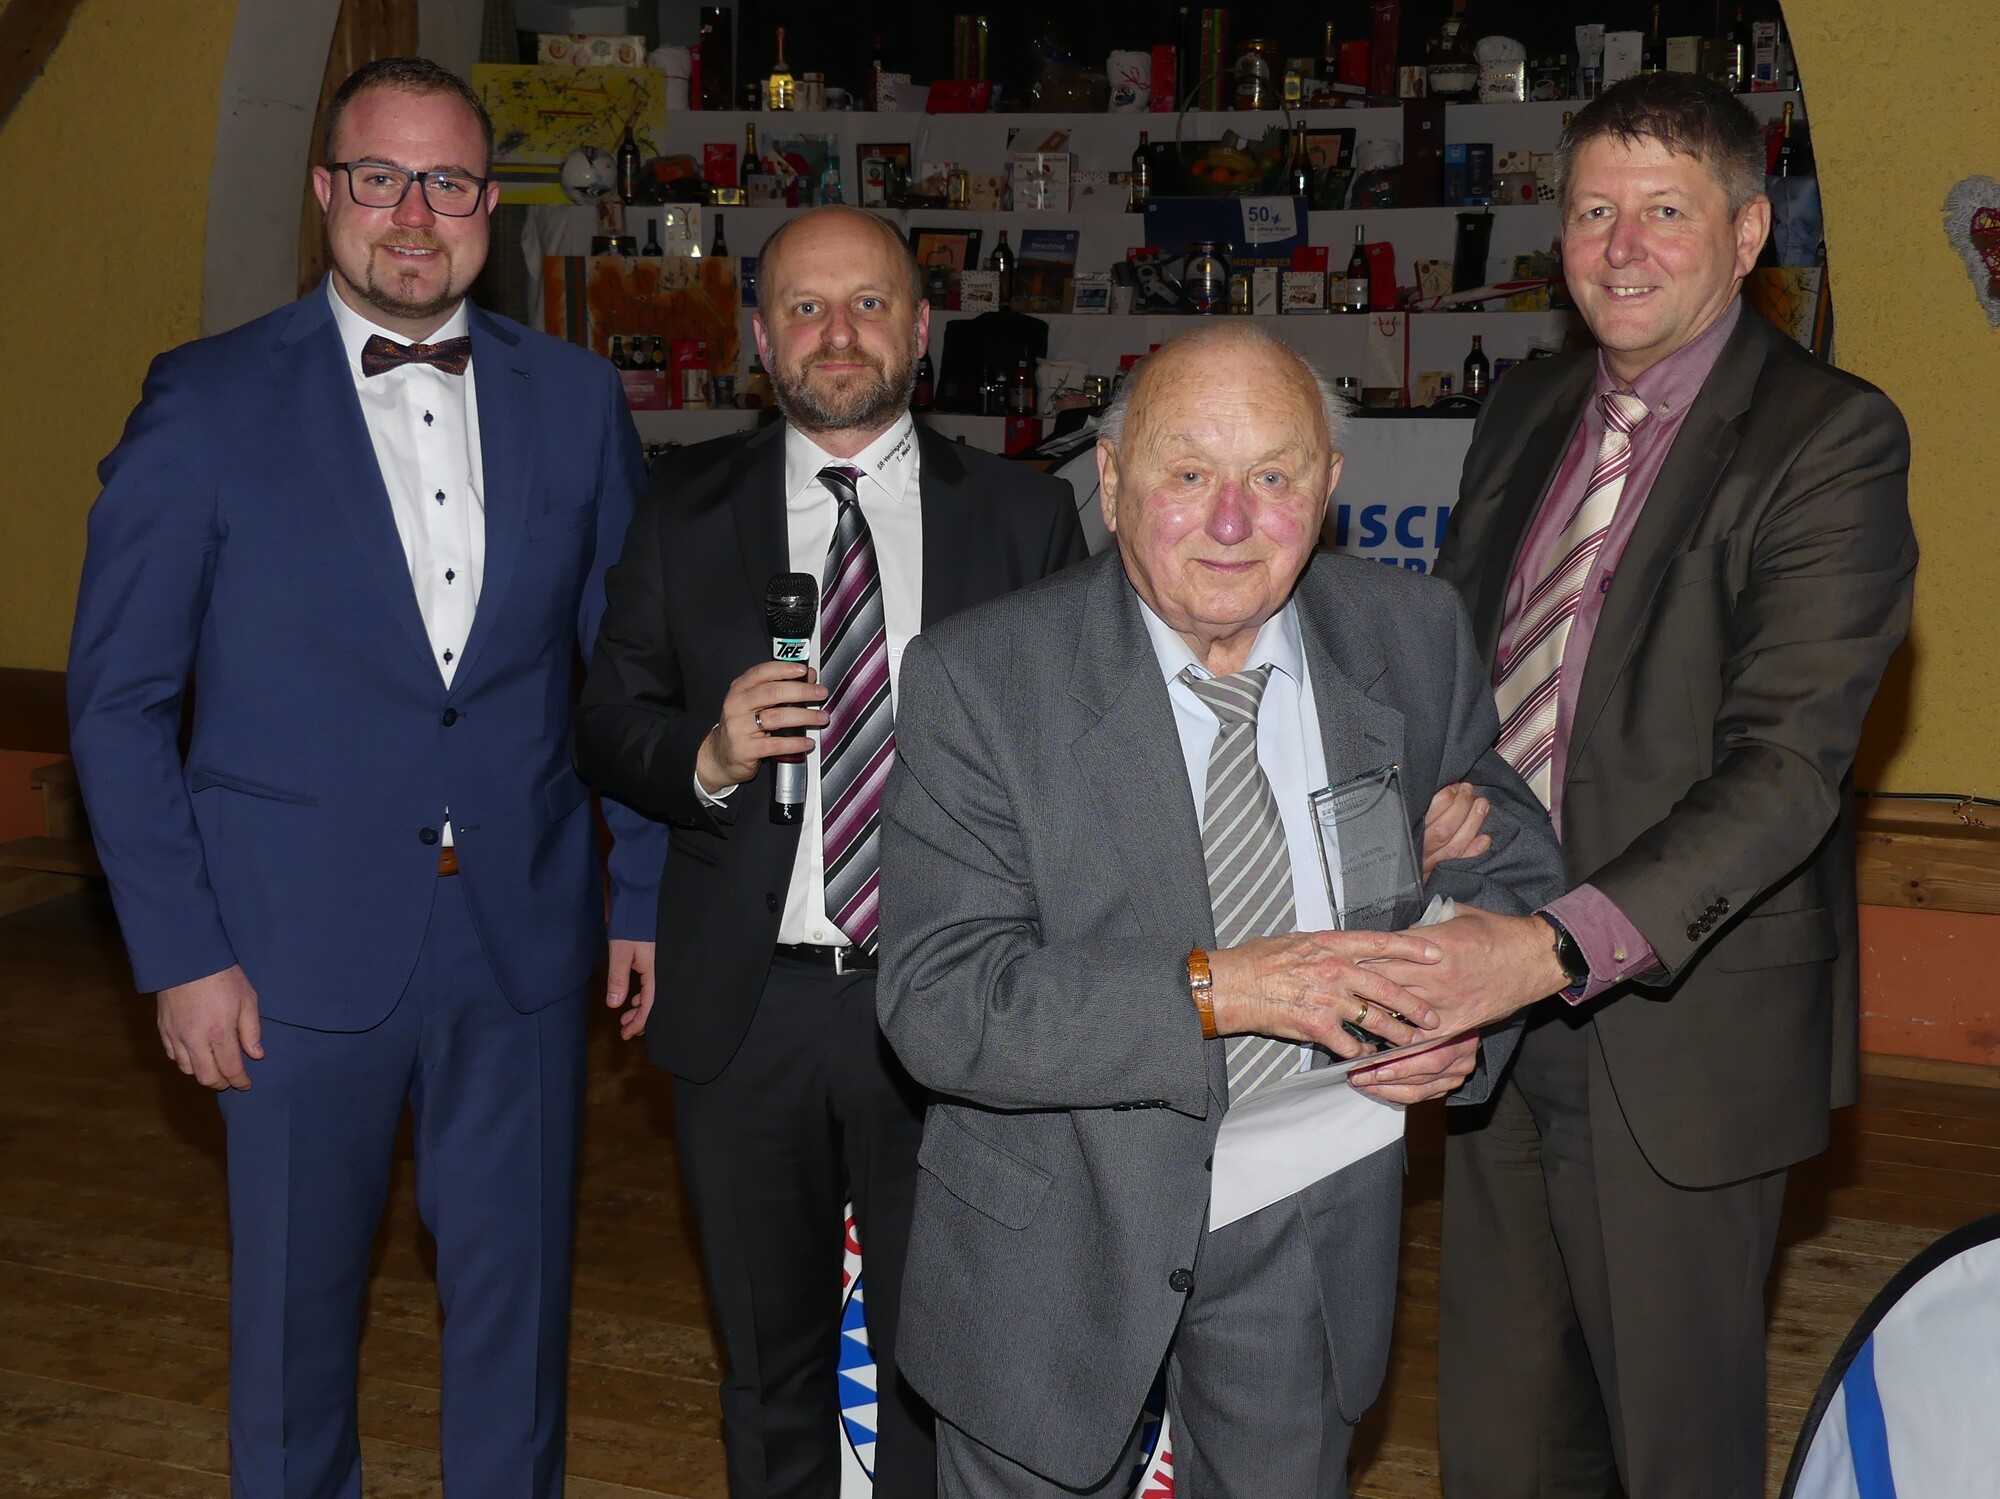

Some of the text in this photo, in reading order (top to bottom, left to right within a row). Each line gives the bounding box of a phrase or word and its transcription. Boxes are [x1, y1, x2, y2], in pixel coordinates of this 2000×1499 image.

[1248, 206, 1270, 222] 50
[1263, 257, 1291, 267] 2023
[1319, 504, 1449, 549] ISC
